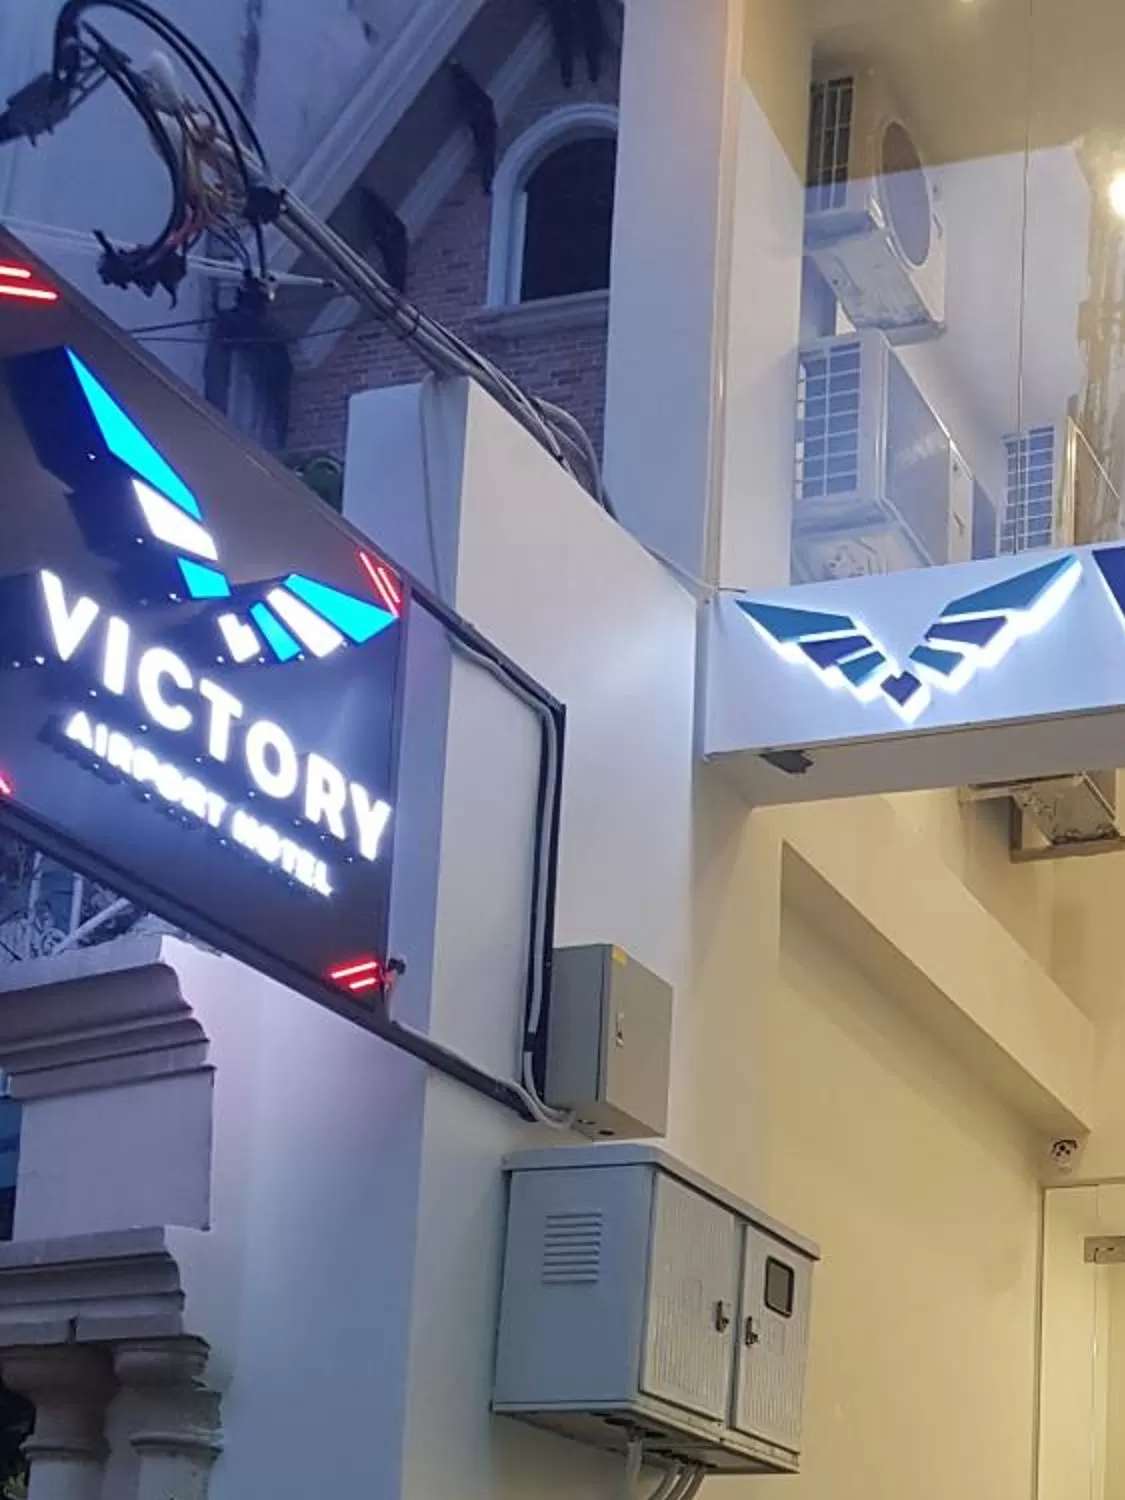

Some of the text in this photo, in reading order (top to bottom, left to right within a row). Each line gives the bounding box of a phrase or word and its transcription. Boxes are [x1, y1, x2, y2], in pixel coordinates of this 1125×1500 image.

[40, 568, 392, 862] VICTORY
[64, 710, 334, 897] AIRPORT HOTEL
